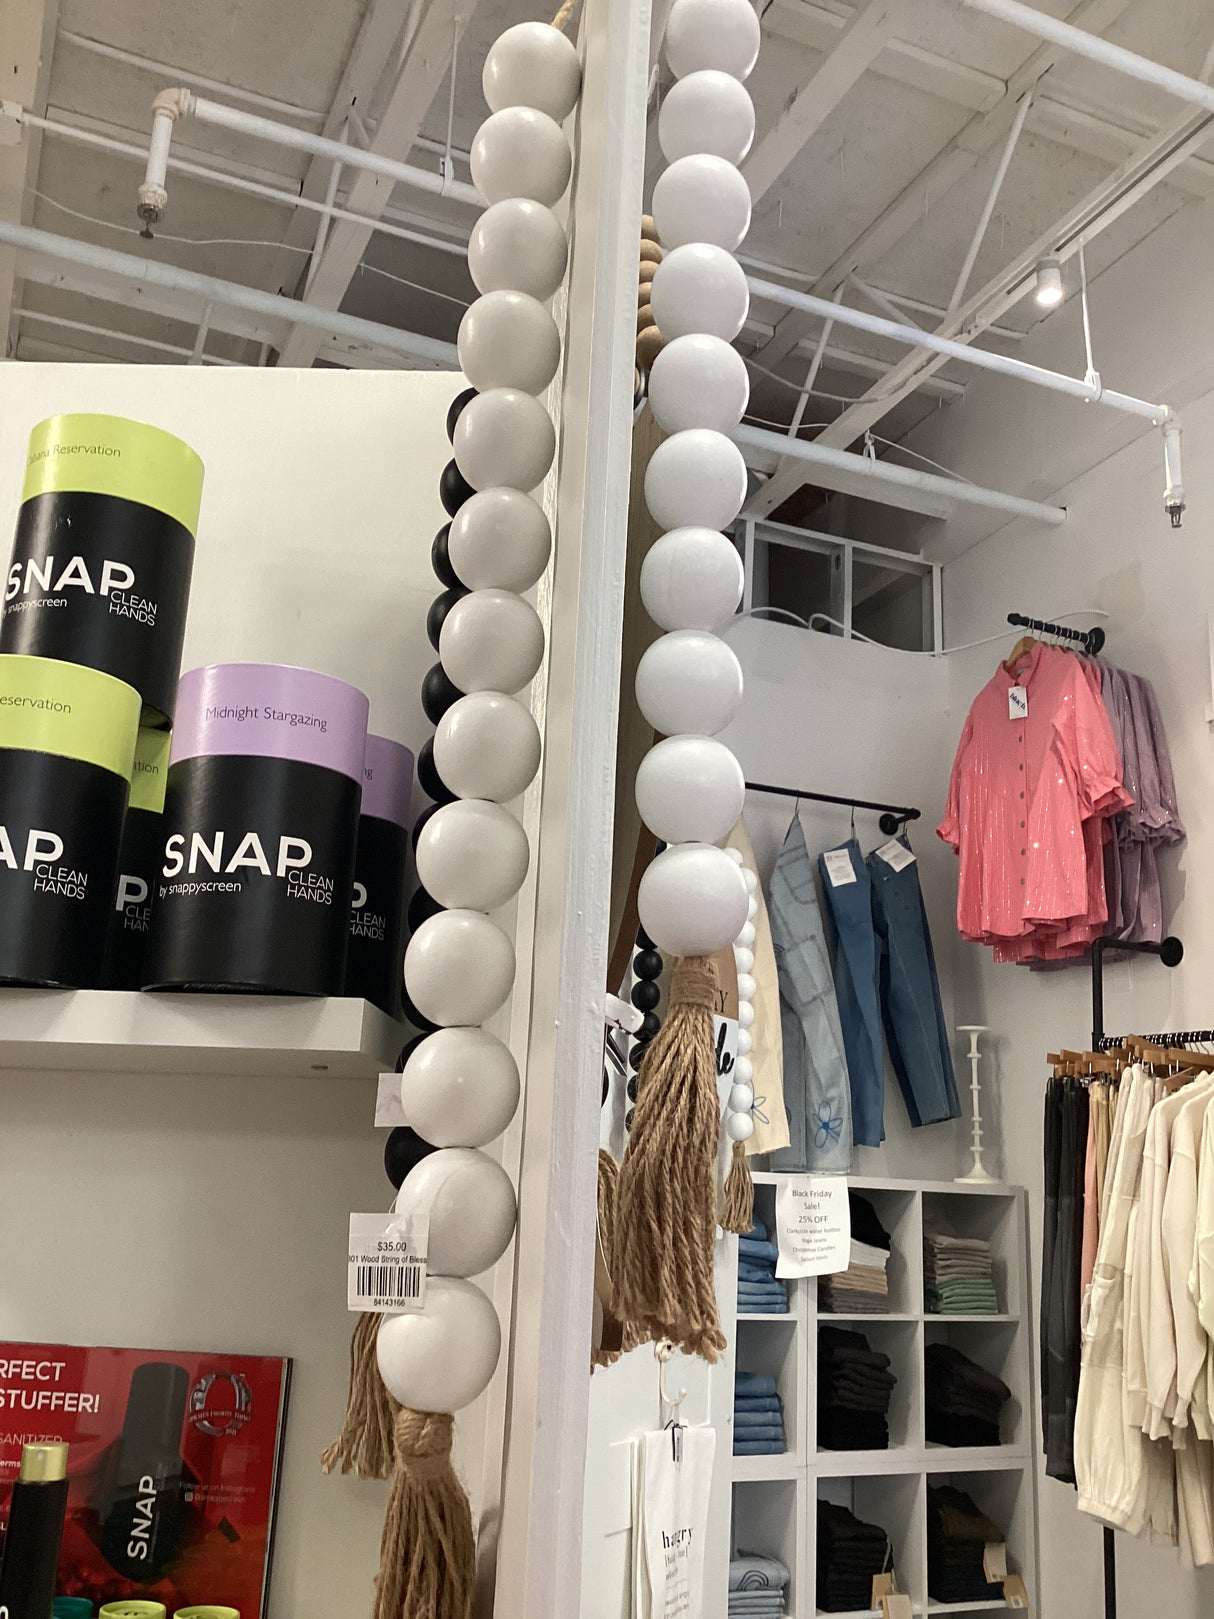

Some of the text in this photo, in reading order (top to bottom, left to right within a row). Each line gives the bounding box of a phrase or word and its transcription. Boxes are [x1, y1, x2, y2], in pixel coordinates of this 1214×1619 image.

[53, 444, 121, 457] Reservation
[5, 555, 135, 601] SNAP
[8, 598, 67, 614] snappyscreen
[110, 591, 157, 614] CLEAN
[109, 603, 155, 626] HANDS
[205, 705, 327, 733] Midnight Stargazing
[162, 831, 313, 878] SNAP
[36, 864, 88, 887] CLEAN
[288, 870, 334, 891] CLEAN
[34, 878, 85, 900] HANDS
[159, 881, 242, 899] by snappyscreen
[287, 884, 332, 905] HANDS
[792, 1189, 832, 1199] Black Friday
[798, 1215, 828, 1223] 25% OFF
[377, 1241, 407, 1252] $35.00
[361, 1255, 380, 1263] Wood
[381, 1255, 400, 1265] String
[401, 1255, 408, 1263] of
[373, 1298, 406, 1307] 84143166
[127, 1475, 157, 1560] SNAP
